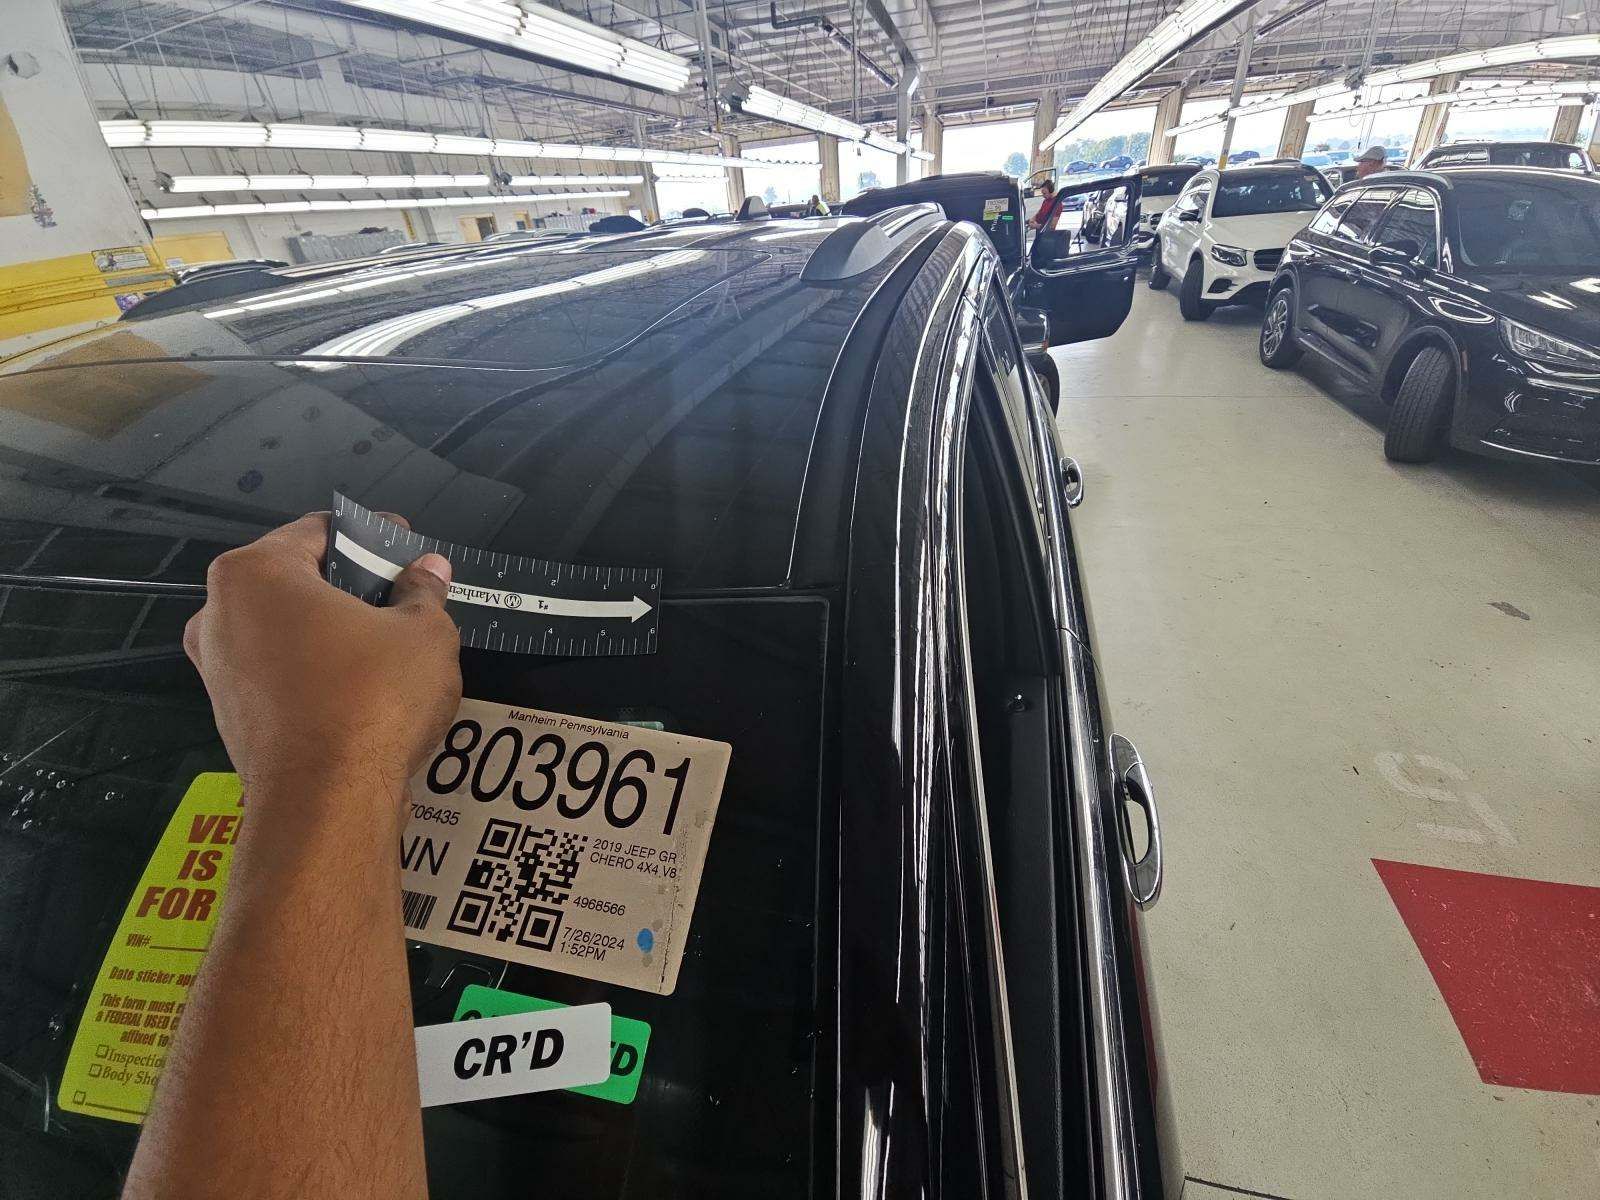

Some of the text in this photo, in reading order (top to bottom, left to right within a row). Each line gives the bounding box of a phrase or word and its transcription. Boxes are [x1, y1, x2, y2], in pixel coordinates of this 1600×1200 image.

[538, 600, 549, 610] #1
[508, 709, 630, 739] Manheim Pennsylvania
[426, 719, 691, 836] 803961
[593, 838, 677, 864] 2019 JEEP GR
[178, 849, 223, 881] IS
[590, 851, 677, 879] CHERO 4X4 V8
[135, 886, 217, 921] FOR
[573, 895, 626, 916] 4968566
[126, 933, 151, 947] VIN#
[563, 926, 625, 951] 7/26/2024
[560, 941, 607, 961] 1:52PM
[109, 966, 133, 981] Date
[136, 969, 175, 984] sticker
[100, 993, 121, 1007] This
[121, 995, 147, 1011] form
[148, 999, 175, 1013] must
[95, 1010, 103, 1022] a
[104, 1010, 142, 1027] FEDERAL
[143, 1014, 169, 1030] USED
[120, 1030, 156, 1046] affixed
[102, 1066, 160, 1087] Body Sho
